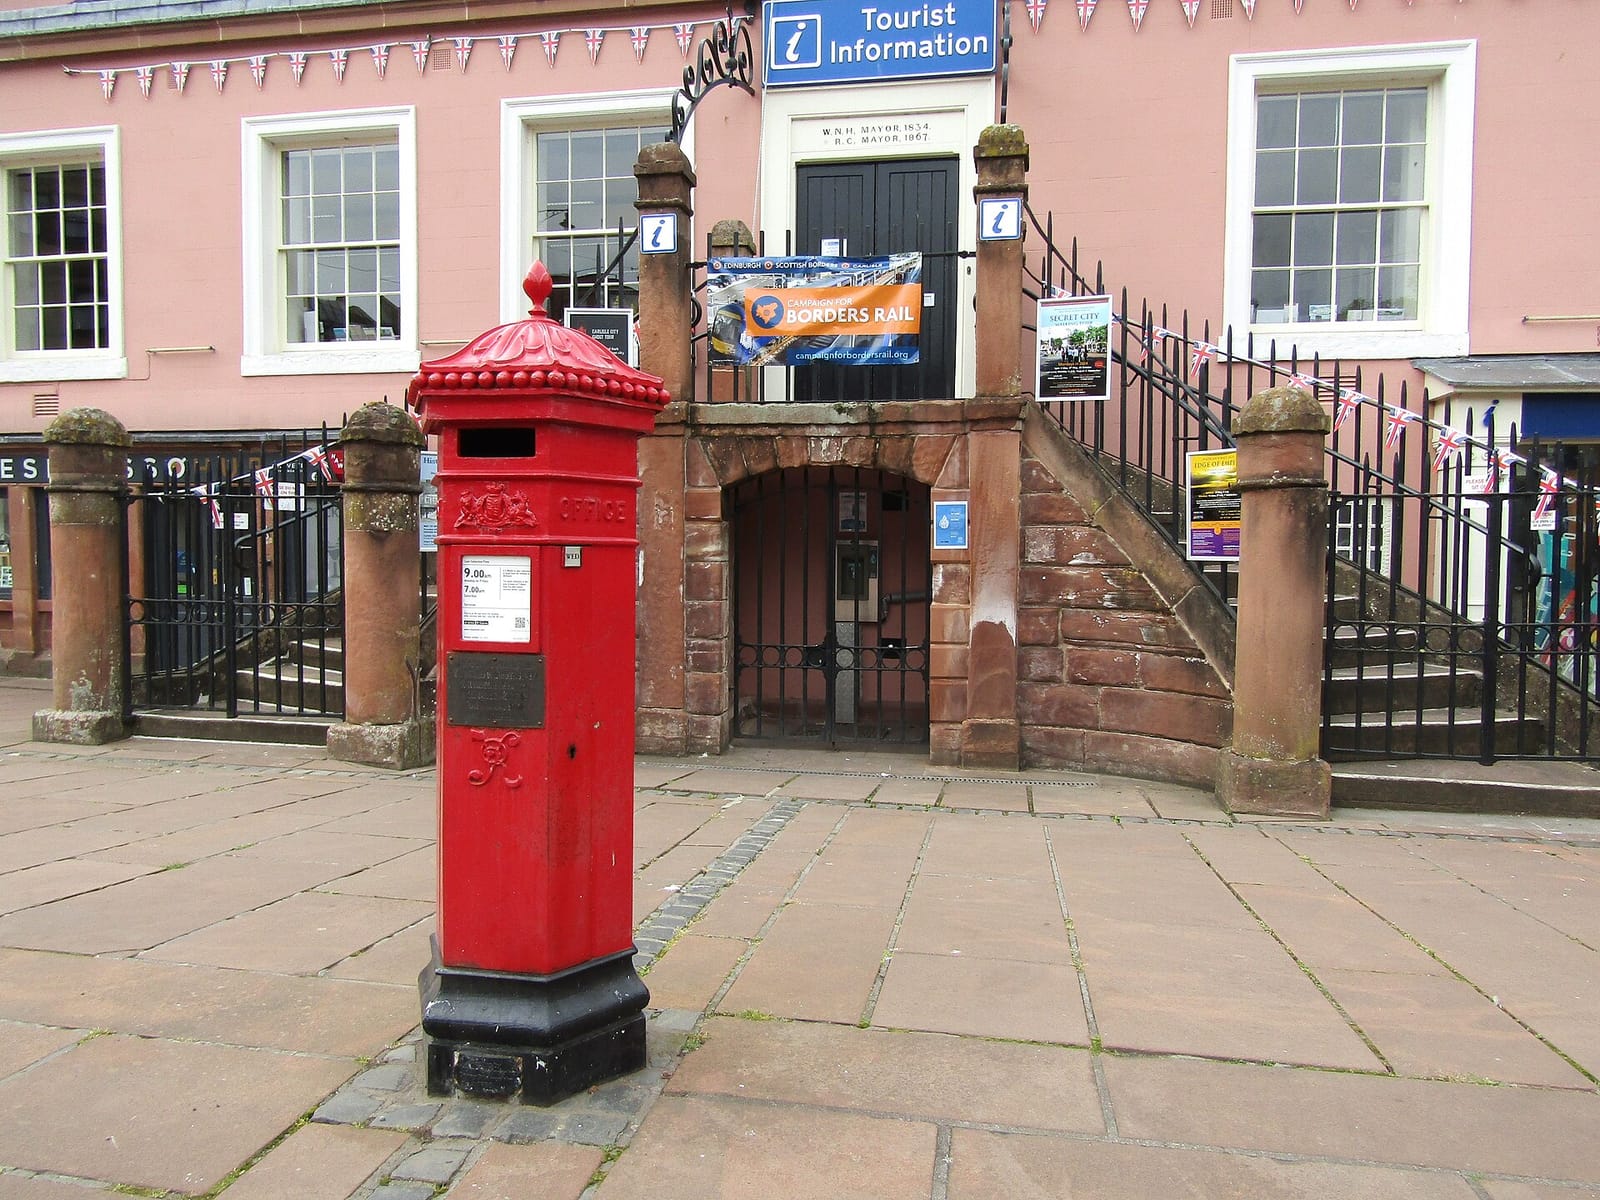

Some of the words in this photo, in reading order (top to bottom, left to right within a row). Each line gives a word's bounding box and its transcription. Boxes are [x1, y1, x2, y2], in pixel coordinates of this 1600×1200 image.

[861, 3, 956, 31] Tourist
[830, 33, 988, 64] Information
[775, 261, 807, 269] SCOTTISH
[787, 298, 834, 307] CAMPAIGN
[835, 297, 853, 306] FOR
[786, 307, 870, 324] BORDERS
[874, 305, 915, 322] RAIL
[1049, 313, 1079, 322] SECRET
[1080, 312, 1100, 321] CITY
[795, 350, 909, 360] campaignforbordersrail.org
[560, 496, 626, 521] OFFICE
